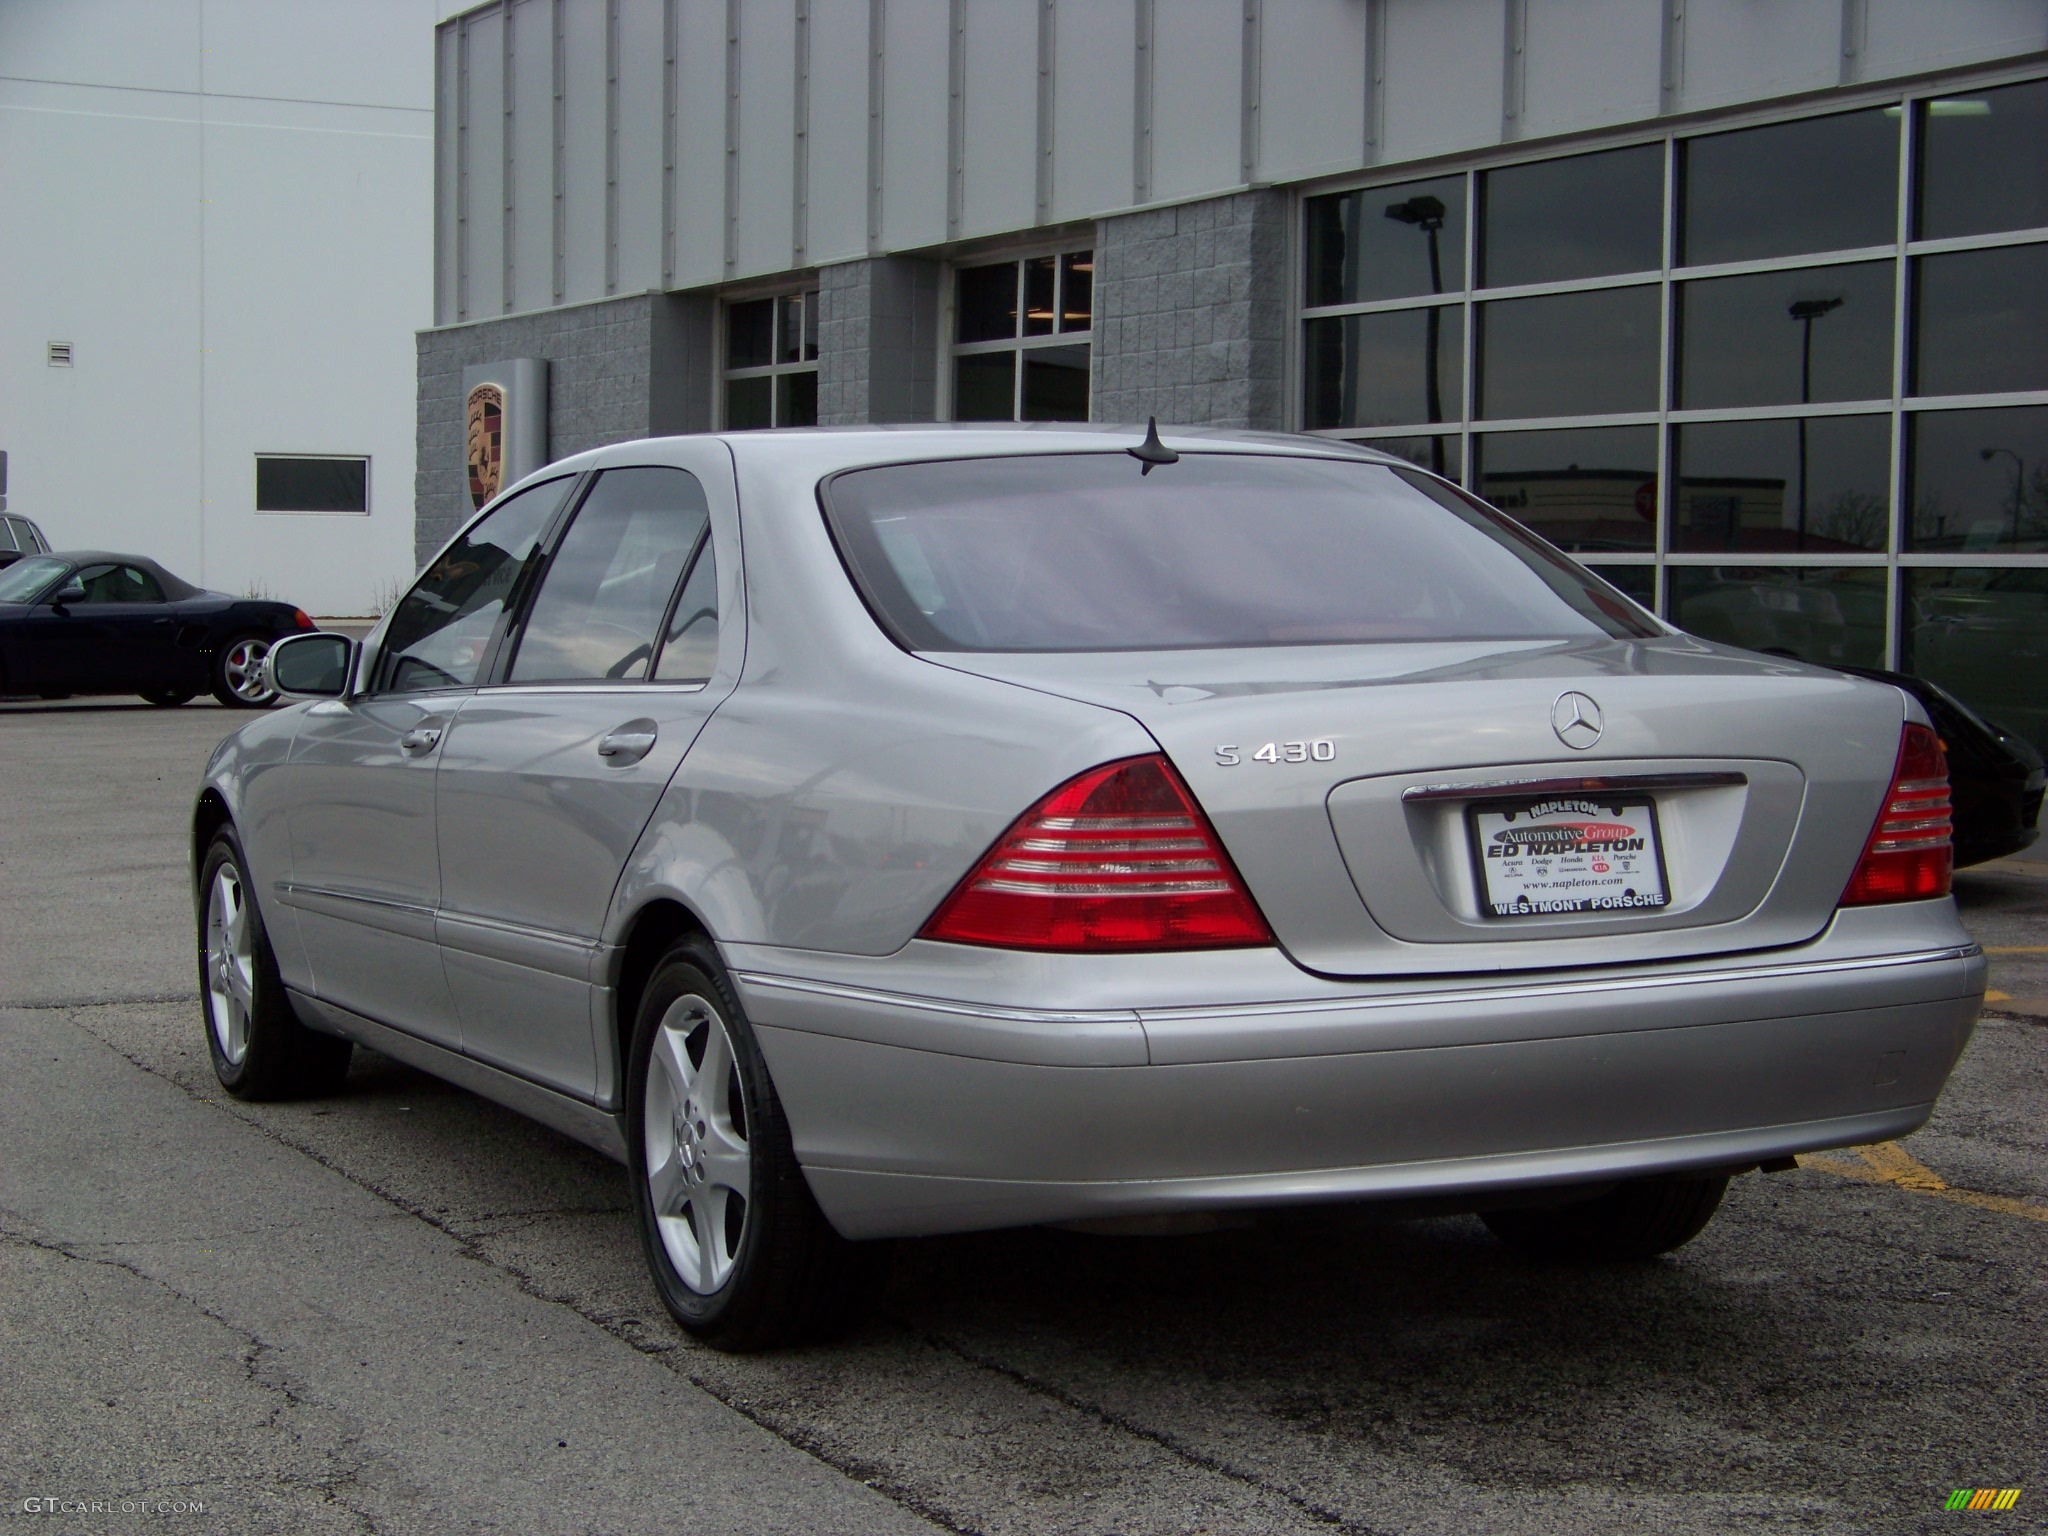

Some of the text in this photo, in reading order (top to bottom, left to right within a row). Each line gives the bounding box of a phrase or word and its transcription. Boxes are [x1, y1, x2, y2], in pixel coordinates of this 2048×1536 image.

[468, 388, 502, 407] PORSCHE
[1215, 739, 1336, 766] S 430
[1530, 799, 1598, 819] NAPLETON
[1487, 837, 1645, 859] ED NAPLETON
[1501, 859, 1523, 867] Acura
[1531, 858, 1553, 866] Dodge
[1560, 856, 1583, 864] Honda
[1523, 877, 1623, 890] www.napleton.com
[1494, 894, 1664, 915] WESTMONT PORSCHE
